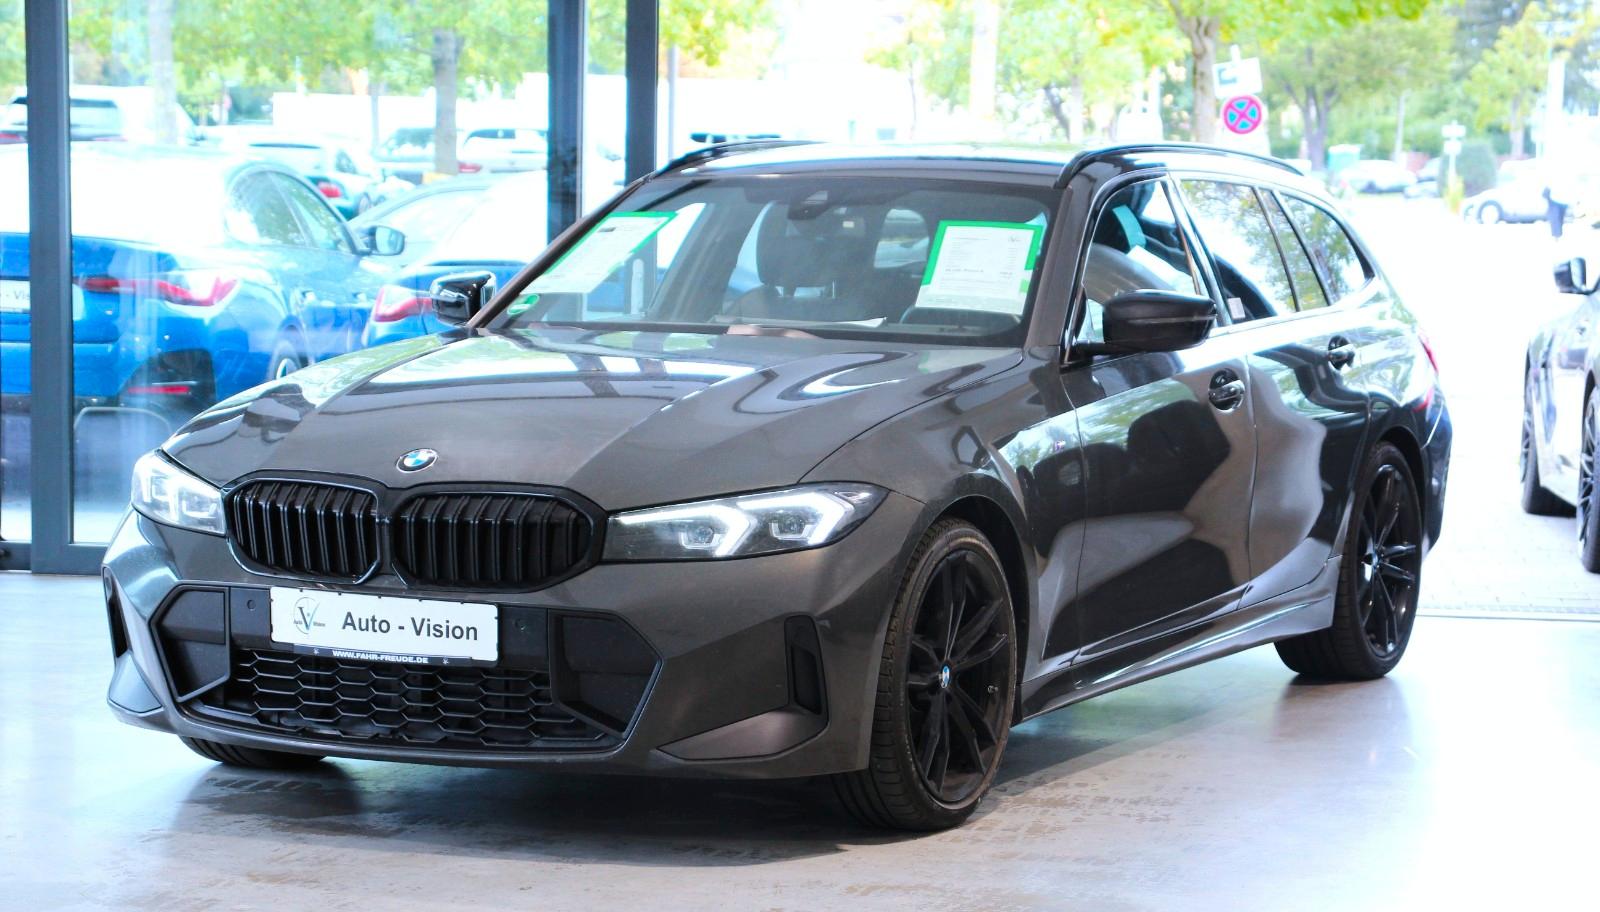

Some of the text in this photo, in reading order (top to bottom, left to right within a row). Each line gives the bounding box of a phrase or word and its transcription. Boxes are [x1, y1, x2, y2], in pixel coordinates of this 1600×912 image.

[342, 612, 390, 633] Auto
[411, 617, 478, 640] Vision
[332, 650, 429, 664] WWW.FAHR-FREUDE.DE
